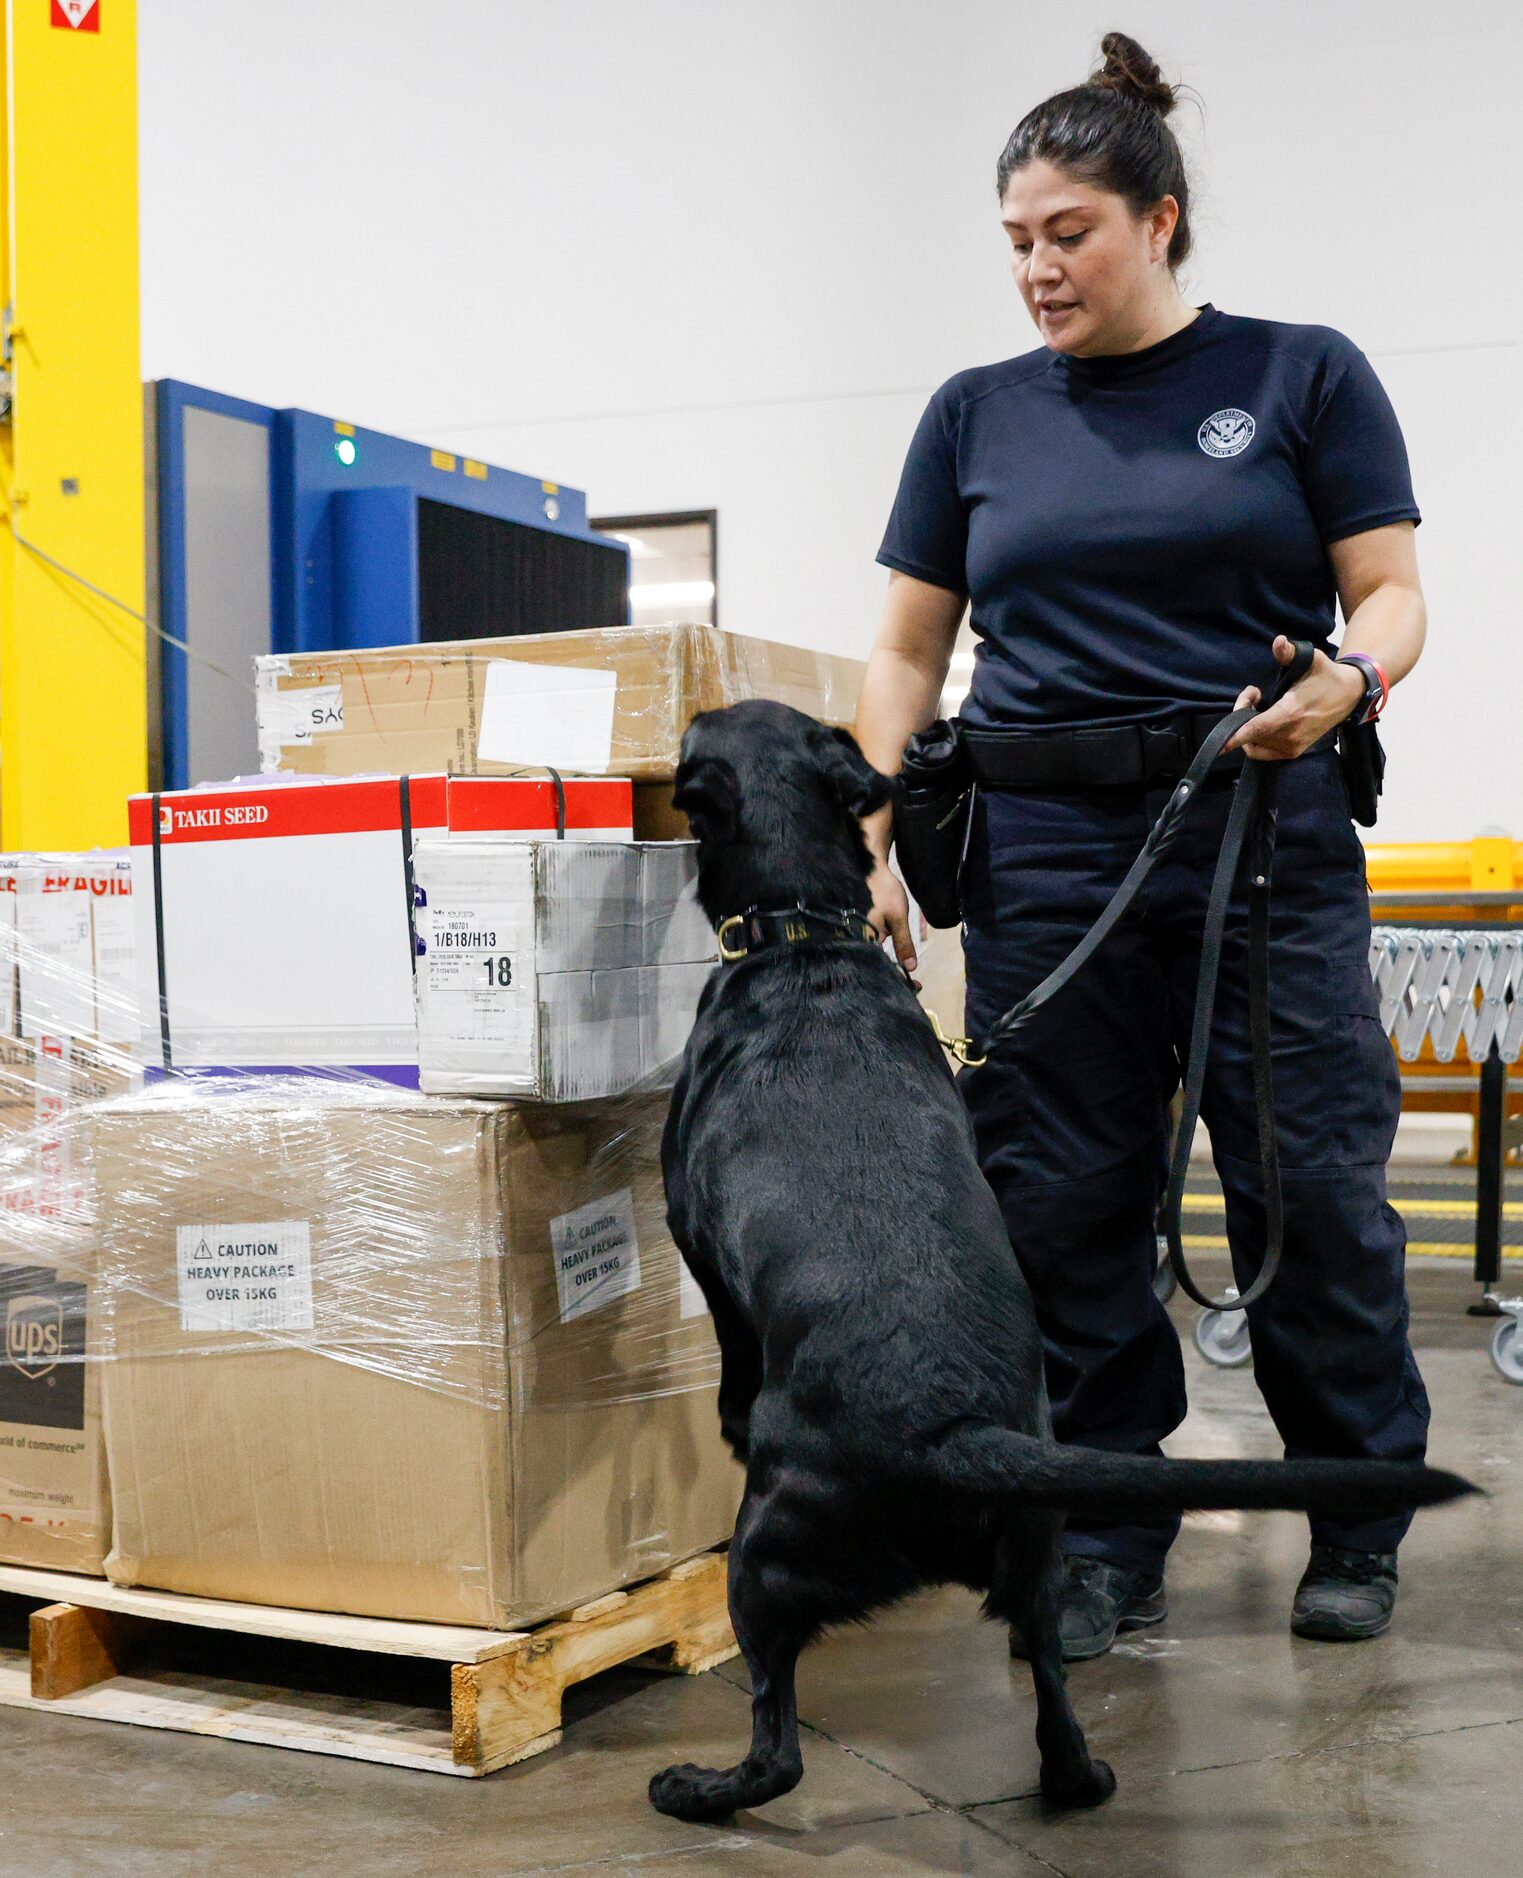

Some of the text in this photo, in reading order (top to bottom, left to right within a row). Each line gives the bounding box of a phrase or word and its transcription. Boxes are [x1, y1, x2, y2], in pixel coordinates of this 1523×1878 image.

[175, 805, 268, 828] TAKII SEED
[434, 932, 497, 947] 1/B18/H13
[483, 957, 512, 987] 18
[579, 1215, 617, 1240] CAUTION
[218, 1243, 278, 1257] CAUTION
[561, 1249, 589, 1271] HEAVY
[187, 1264, 295, 1279] HEAVY PACKAGE
[575, 1256, 620, 1287] OVER 15KG
[206, 1287, 277, 1301] OVER 15KG
[10, 1319, 60, 1365] ups
[16, 1437, 26, 1448] of
